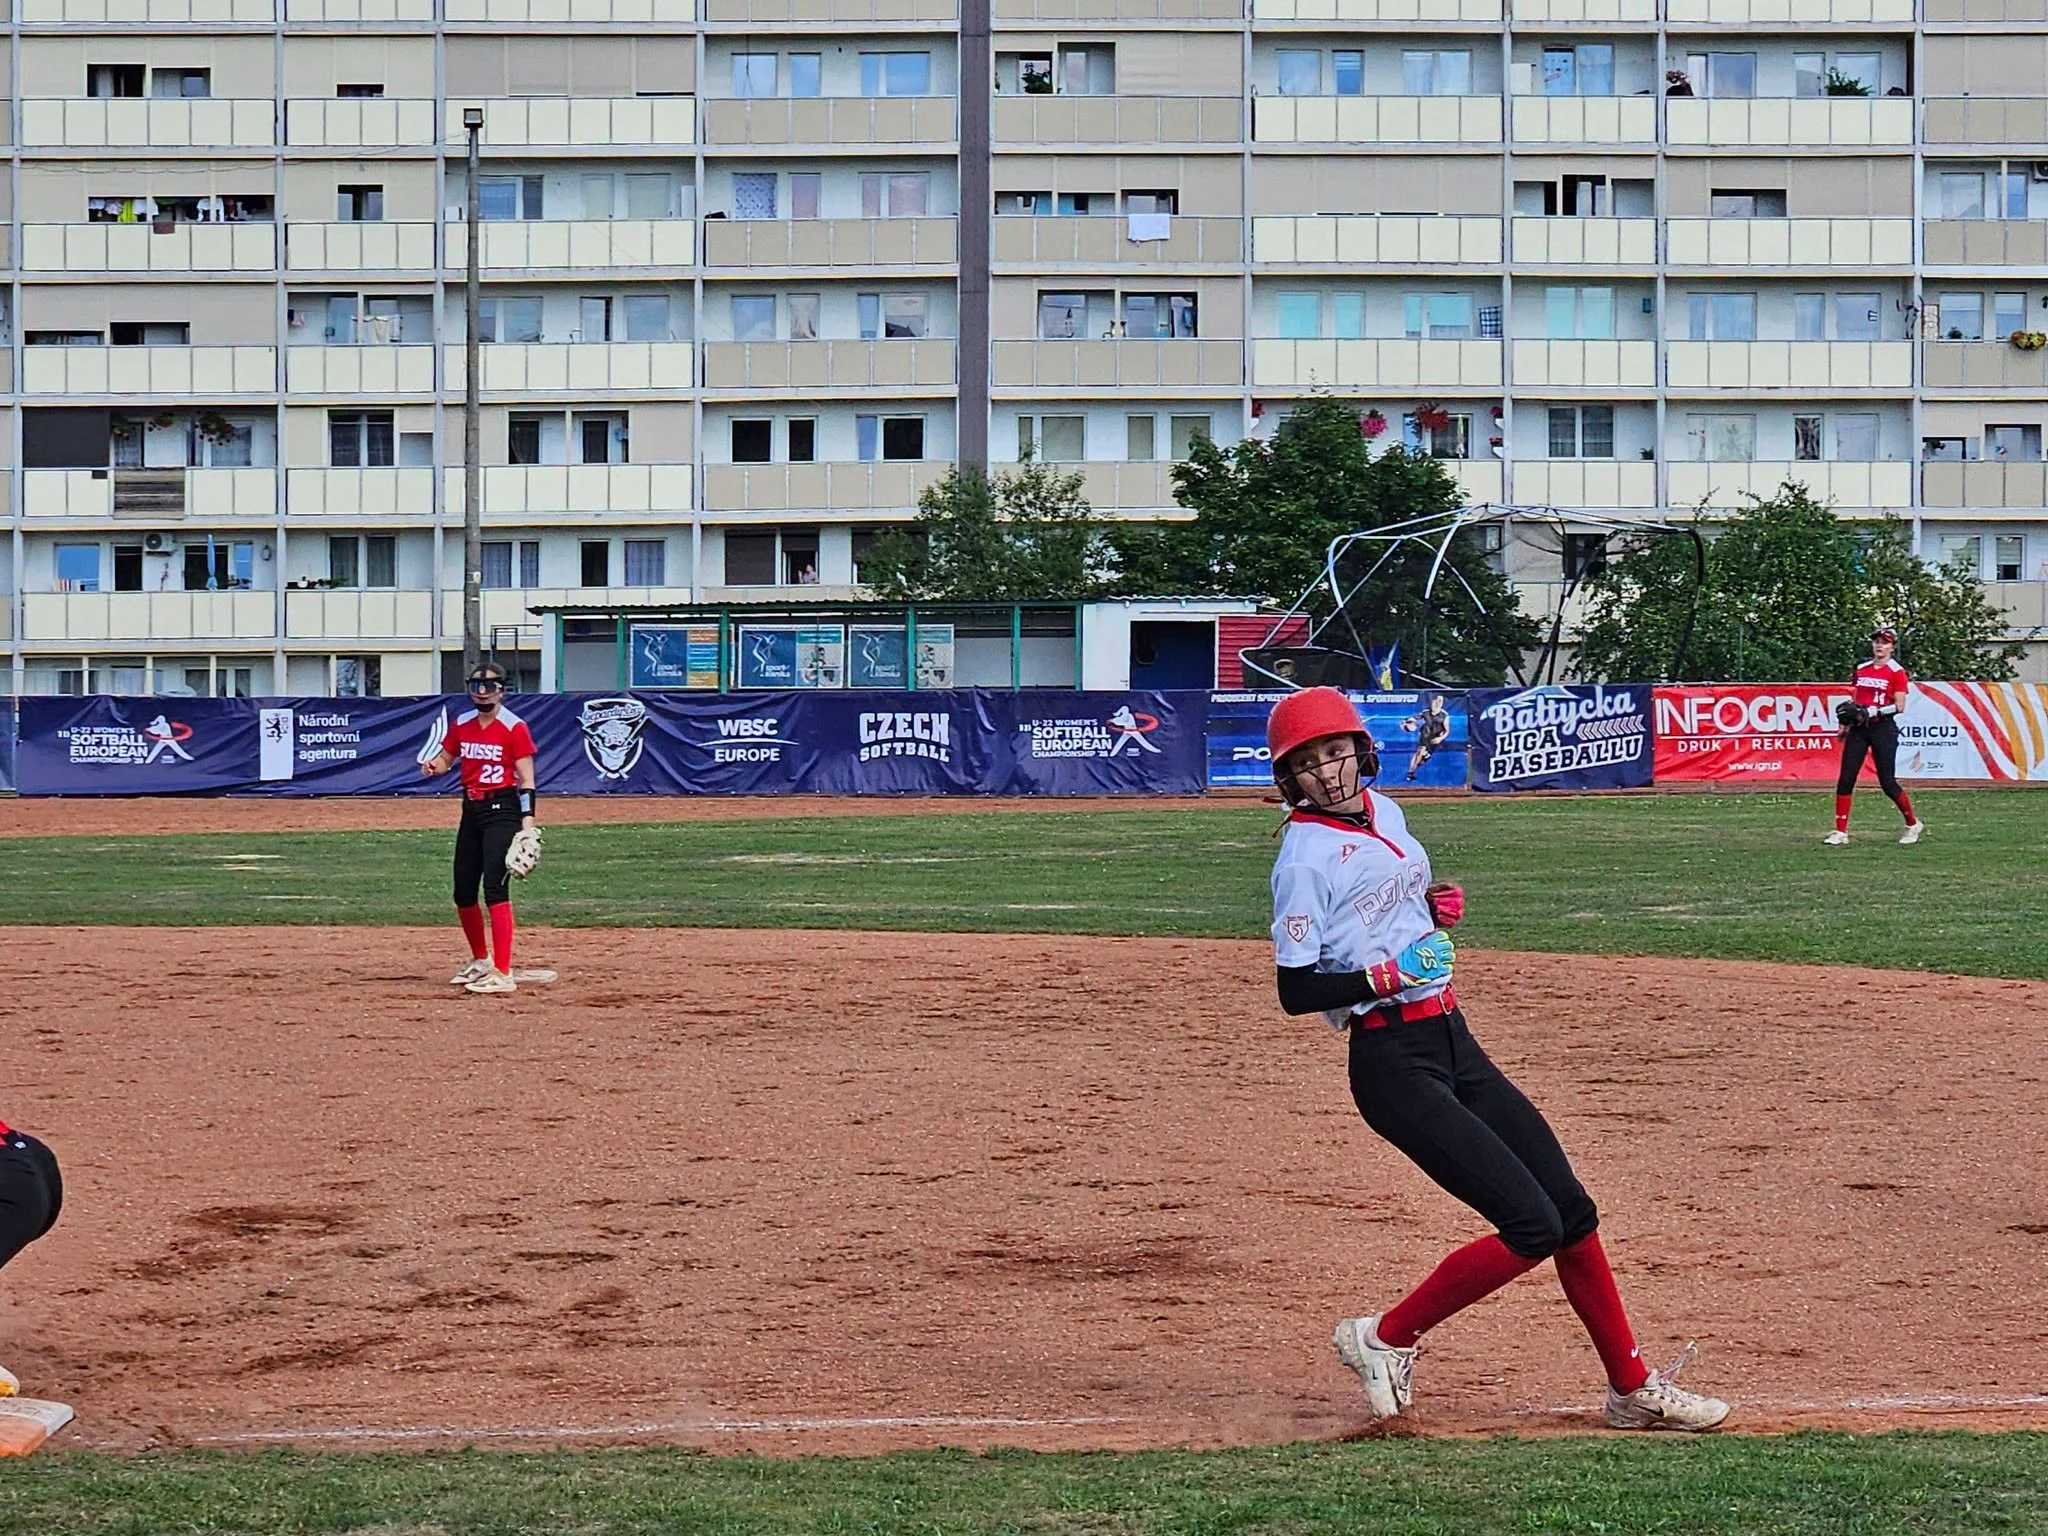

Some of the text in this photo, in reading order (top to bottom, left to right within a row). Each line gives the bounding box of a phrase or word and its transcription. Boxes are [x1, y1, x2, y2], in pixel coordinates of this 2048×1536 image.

[299, 713, 350, 727] Národní
[717, 718, 778, 737] WBSC
[859, 712, 950, 746] CZECH
[1032, 727, 1111, 739] SOFTBALL
[70, 734, 147, 746] SOFTBALL
[299, 730, 360, 747] sportovní
[1032, 738, 1112, 751] EUROPEAN
[1498, 728, 1558, 756] LIGA
[1678, 740, 1721, 753] DRUK
[1752, 738, 1832, 751] REKLAMA
[70, 746, 148, 757] EUROPEAN
[299, 748, 357, 762] agentura
[715, 748, 780, 763] EUROPE
[860, 742, 950, 763] SOFTBALL
[1492, 736, 1642, 780] BASEBALLU
[479, 764, 505, 784] 22
